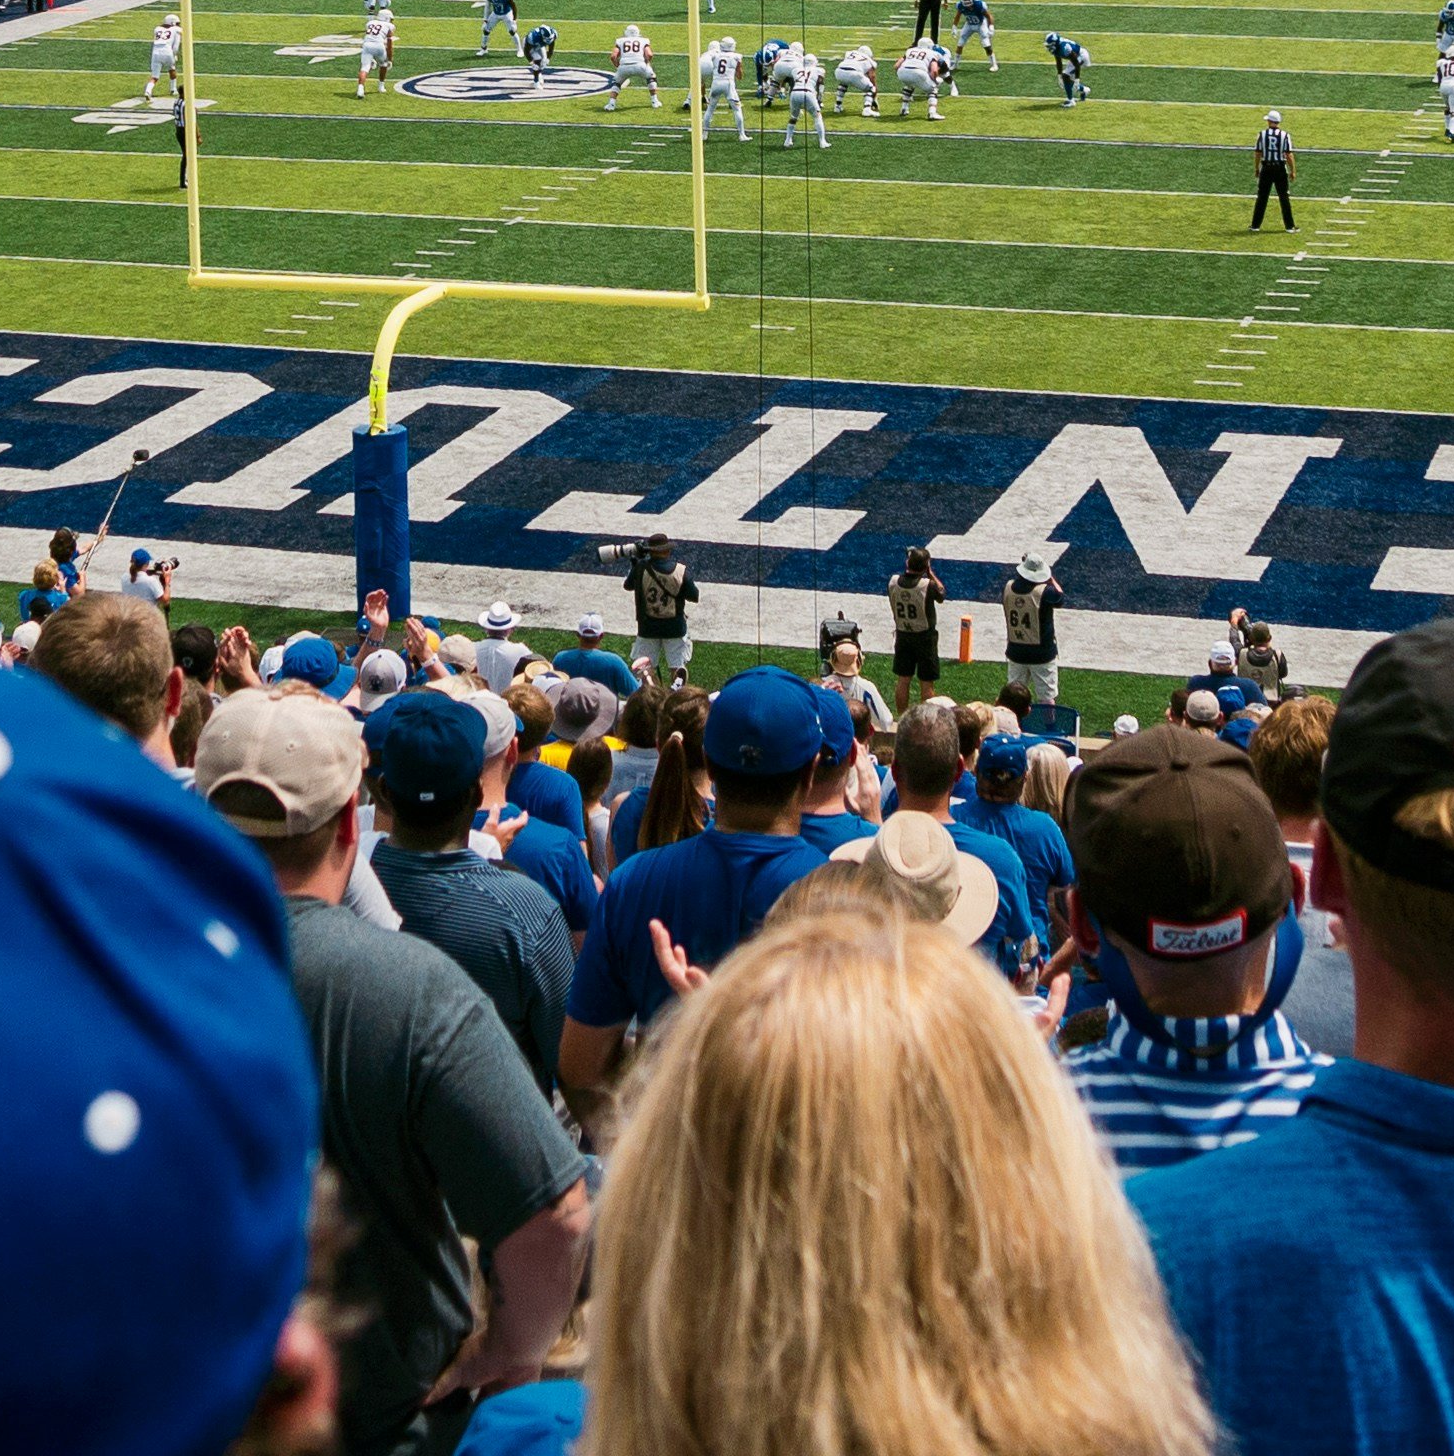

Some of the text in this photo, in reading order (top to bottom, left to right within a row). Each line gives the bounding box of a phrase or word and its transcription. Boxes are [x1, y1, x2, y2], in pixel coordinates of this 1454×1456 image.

[622, 40, 641, 54] 68
[717, 59, 727, 75] 6
[1267, 135, 1278, 151] R
[896, 604, 916, 619] 28
[1010, 608, 1031, 628] 64
